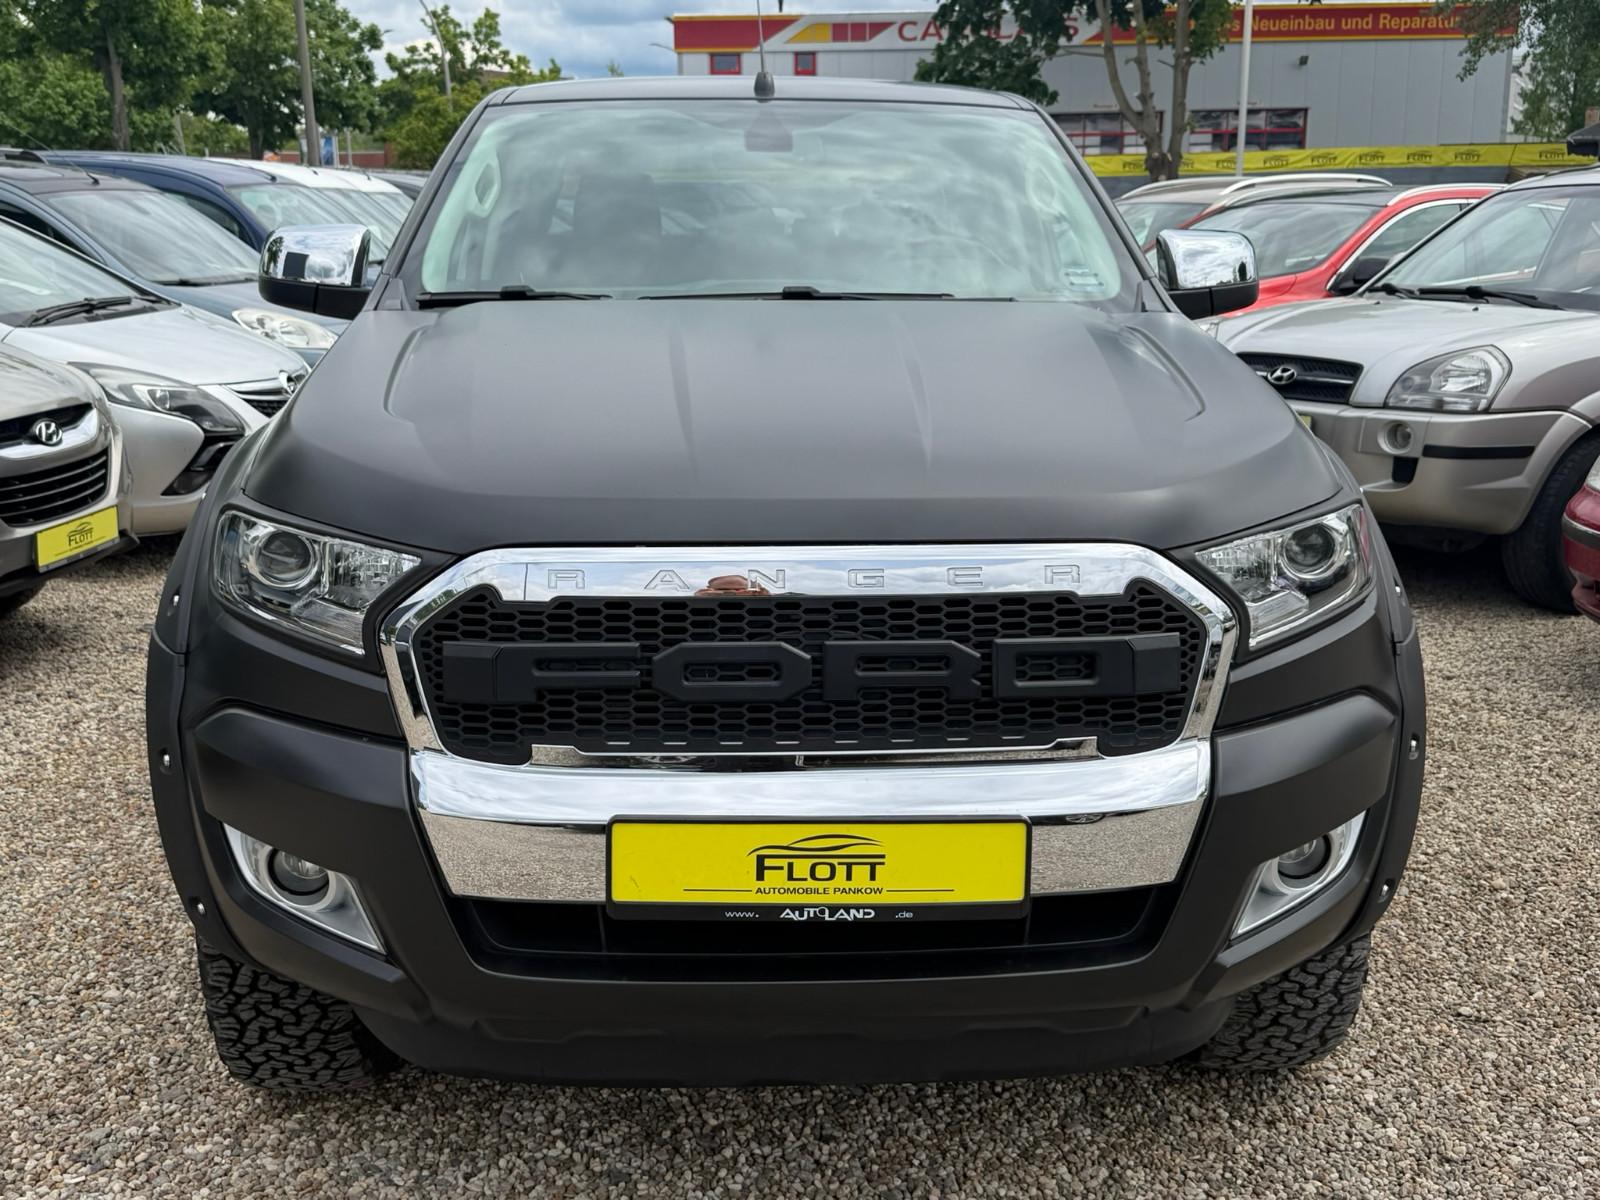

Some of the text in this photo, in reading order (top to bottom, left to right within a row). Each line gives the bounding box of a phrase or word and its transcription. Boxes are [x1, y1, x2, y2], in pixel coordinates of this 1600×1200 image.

[1252, 14, 1335, 31] Neueinbau
[1341, 14, 1373, 30] und
[68, 527, 94, 547] FLOTT
[547, 565, 1081, 590] RANGER
[443, 633, 1181, 702] FORD
[755, 854, 886, 882] FLOTT
[755, 887, 884, 895] AUTOMOBILE PANKOW
[895, 910, 914, 919] .de
